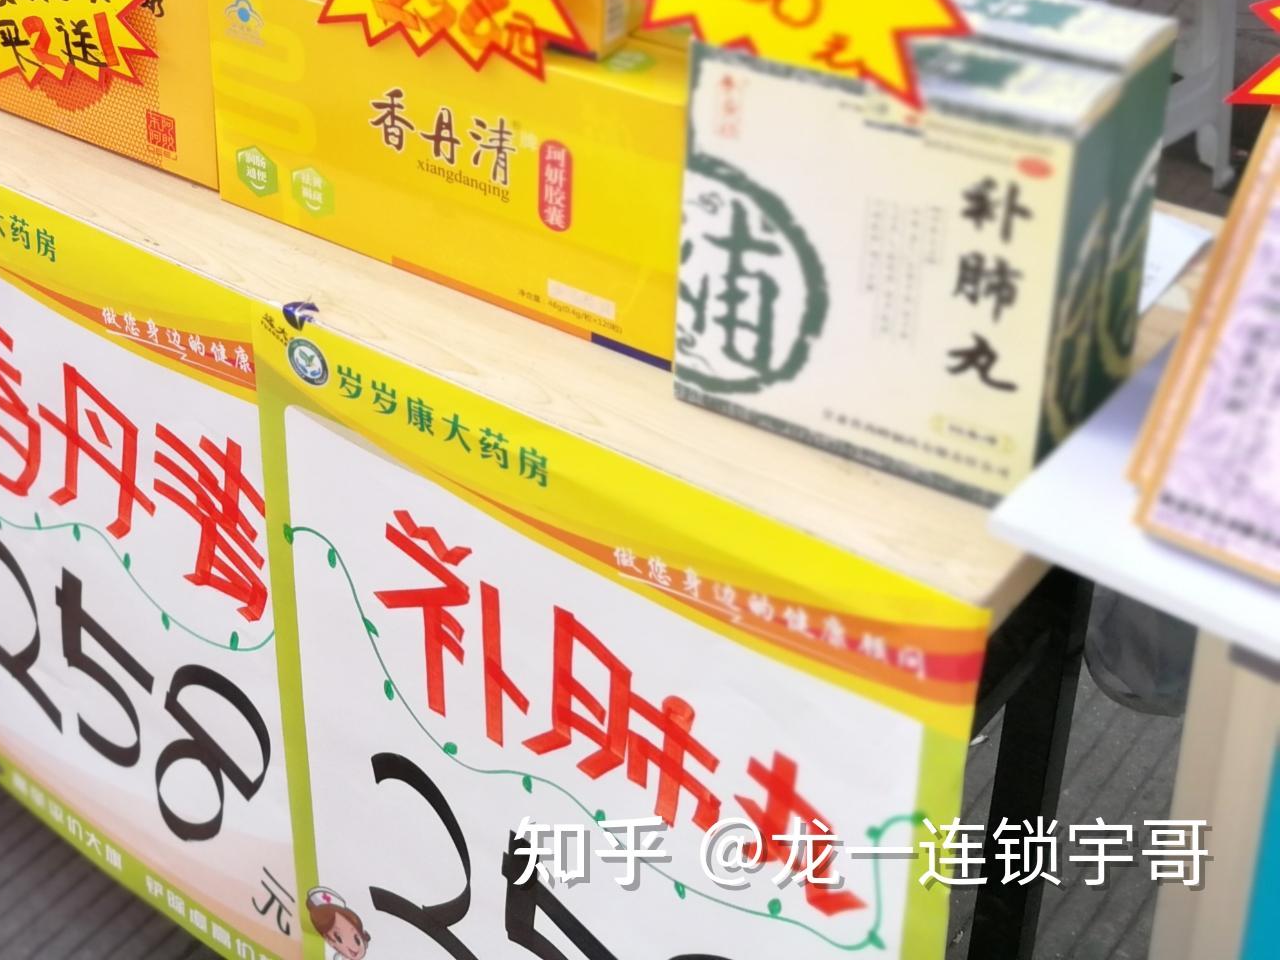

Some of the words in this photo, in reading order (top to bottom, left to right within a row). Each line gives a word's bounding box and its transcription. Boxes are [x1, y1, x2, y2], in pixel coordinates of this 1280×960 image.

[369, 88, 519, 187] 香丹清
[417, 159, 511, 202] xiangdanqing
[101, 306, 253, 373] 做您身边的健康
[946, 176, 1036, 393] 补肺丸
[336, 363, 550, 490] 岁岁康大药房
[613, 544, 926, 682] 做您身边的健康顾问
[373, 509, 868, 916] 补肺丸
[251, 866, 295, 936] 元
